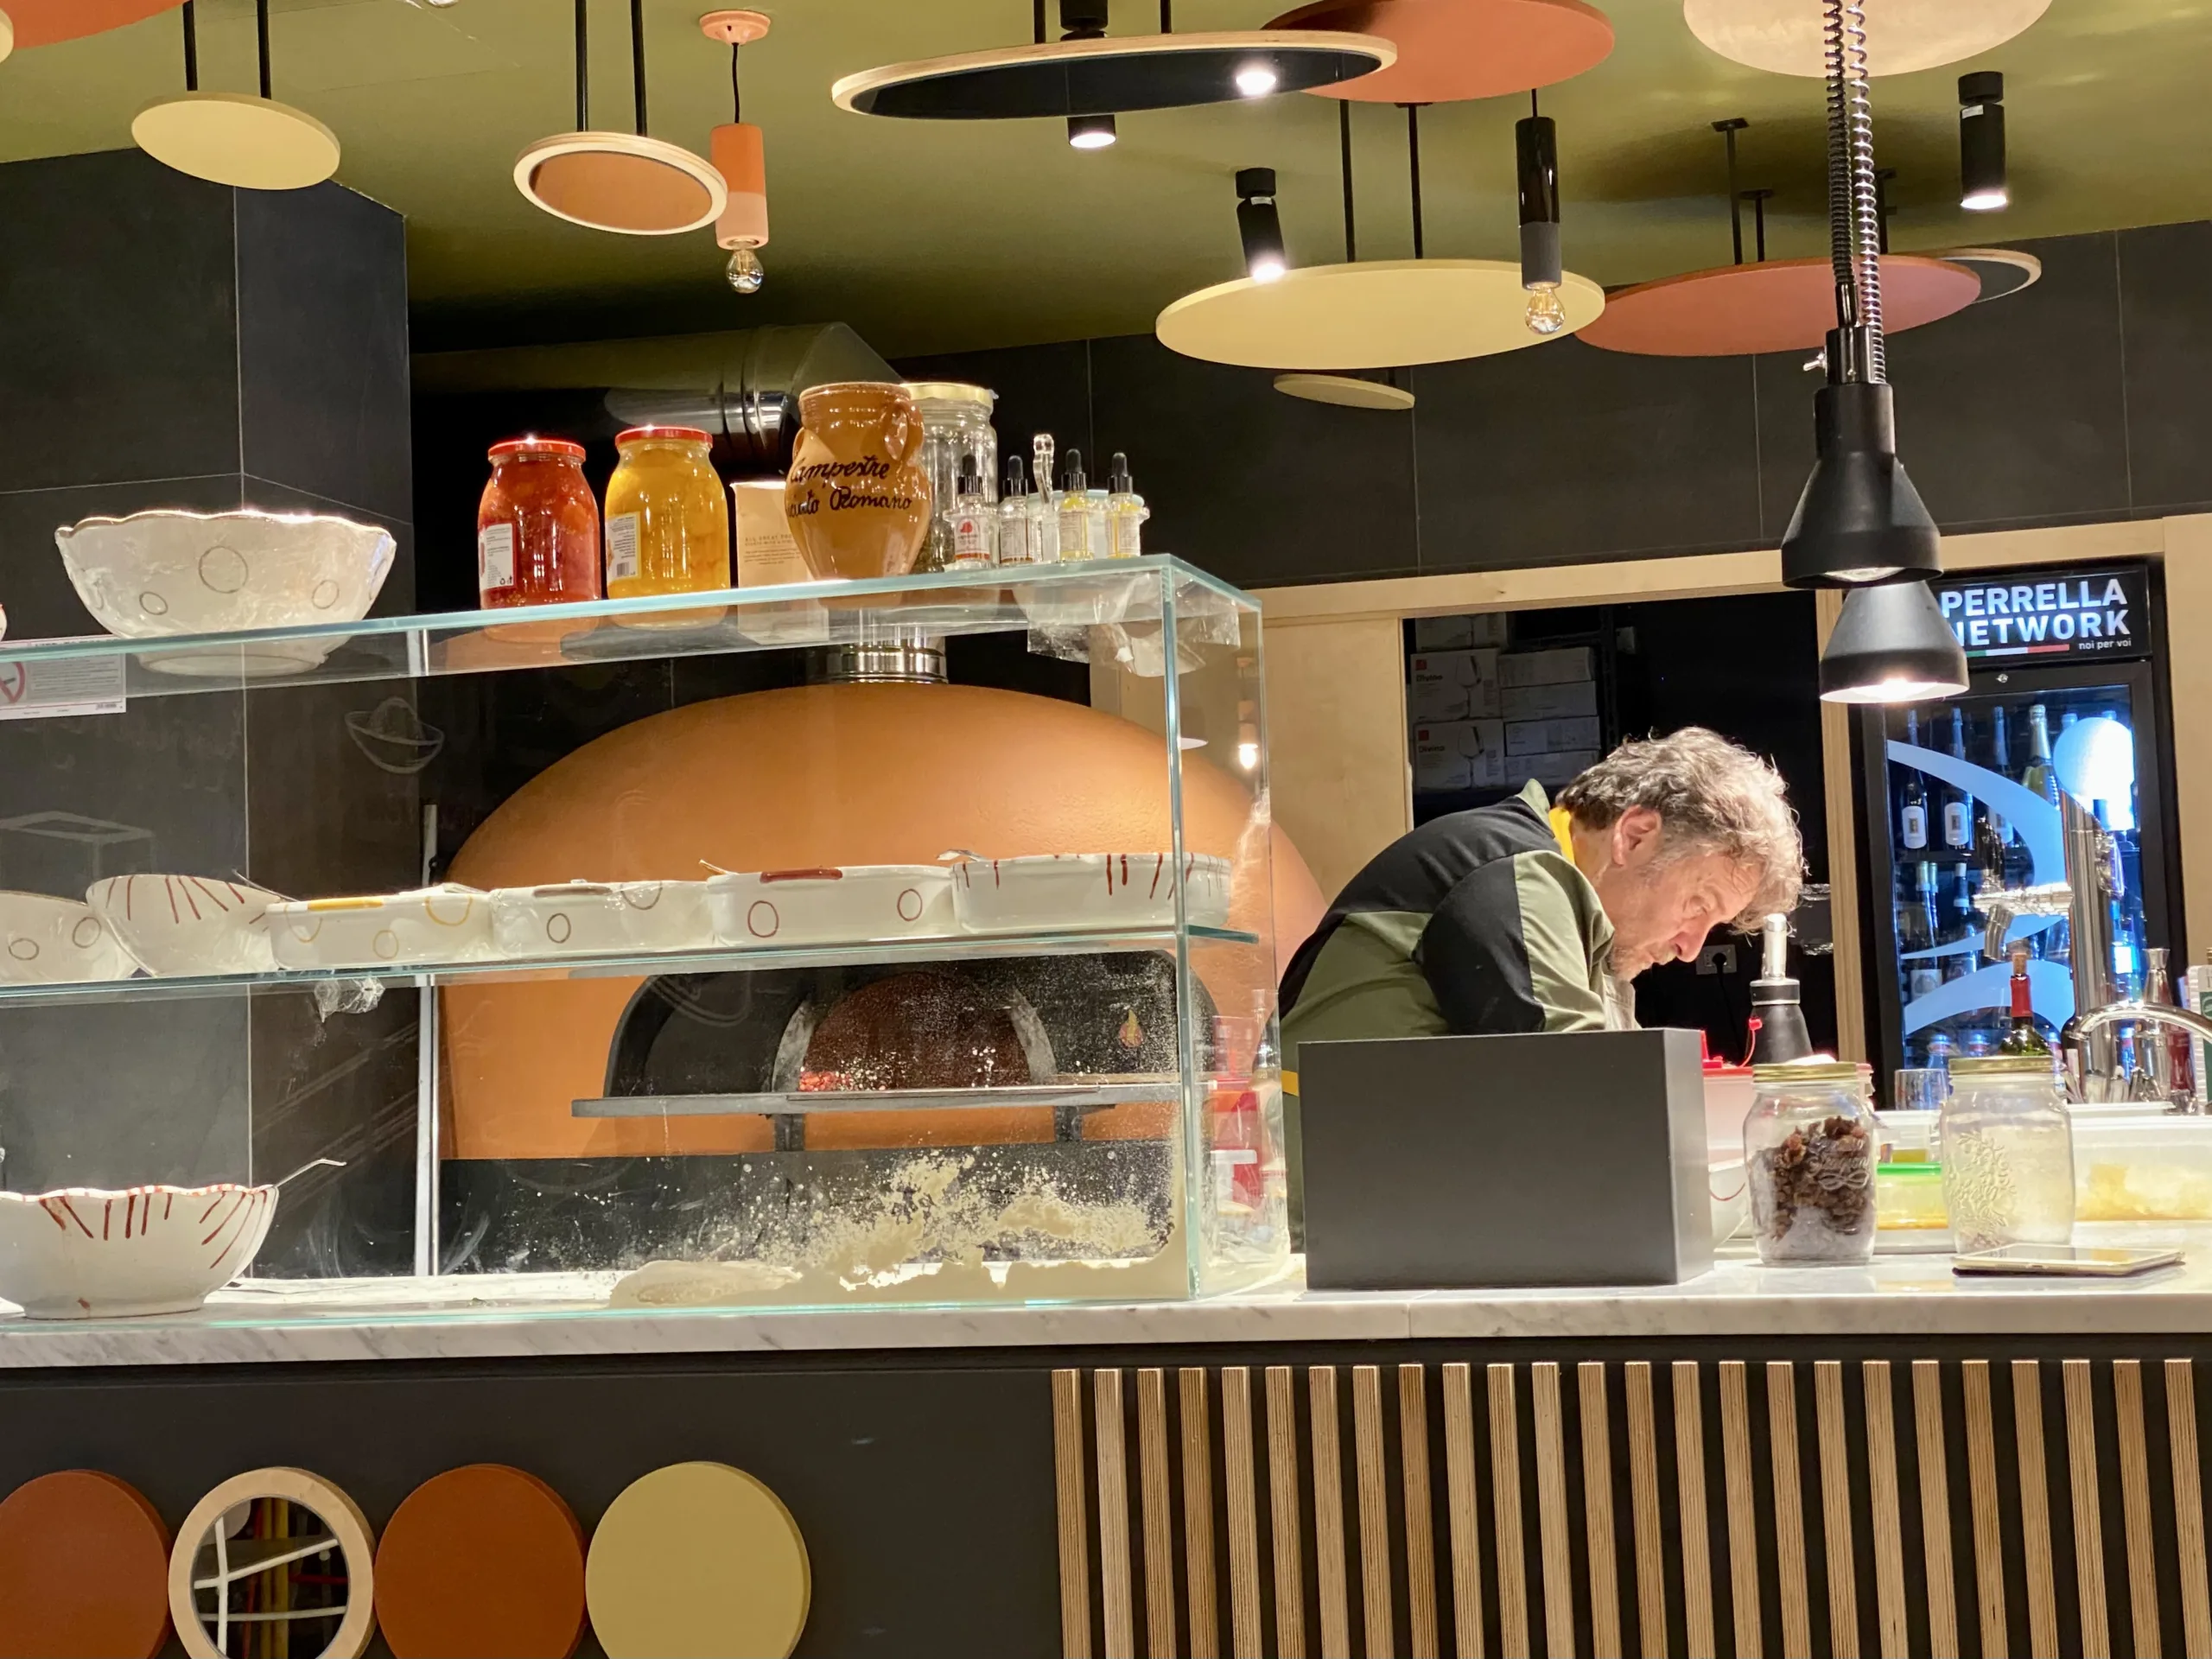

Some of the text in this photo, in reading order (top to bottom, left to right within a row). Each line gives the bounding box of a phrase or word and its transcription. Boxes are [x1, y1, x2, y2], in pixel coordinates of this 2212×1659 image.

[830, 486, 912, 511] Romano
[1941, 578, 2127, 618] PERRELLA
[2079, 638, 2132, 650] noi per voi
